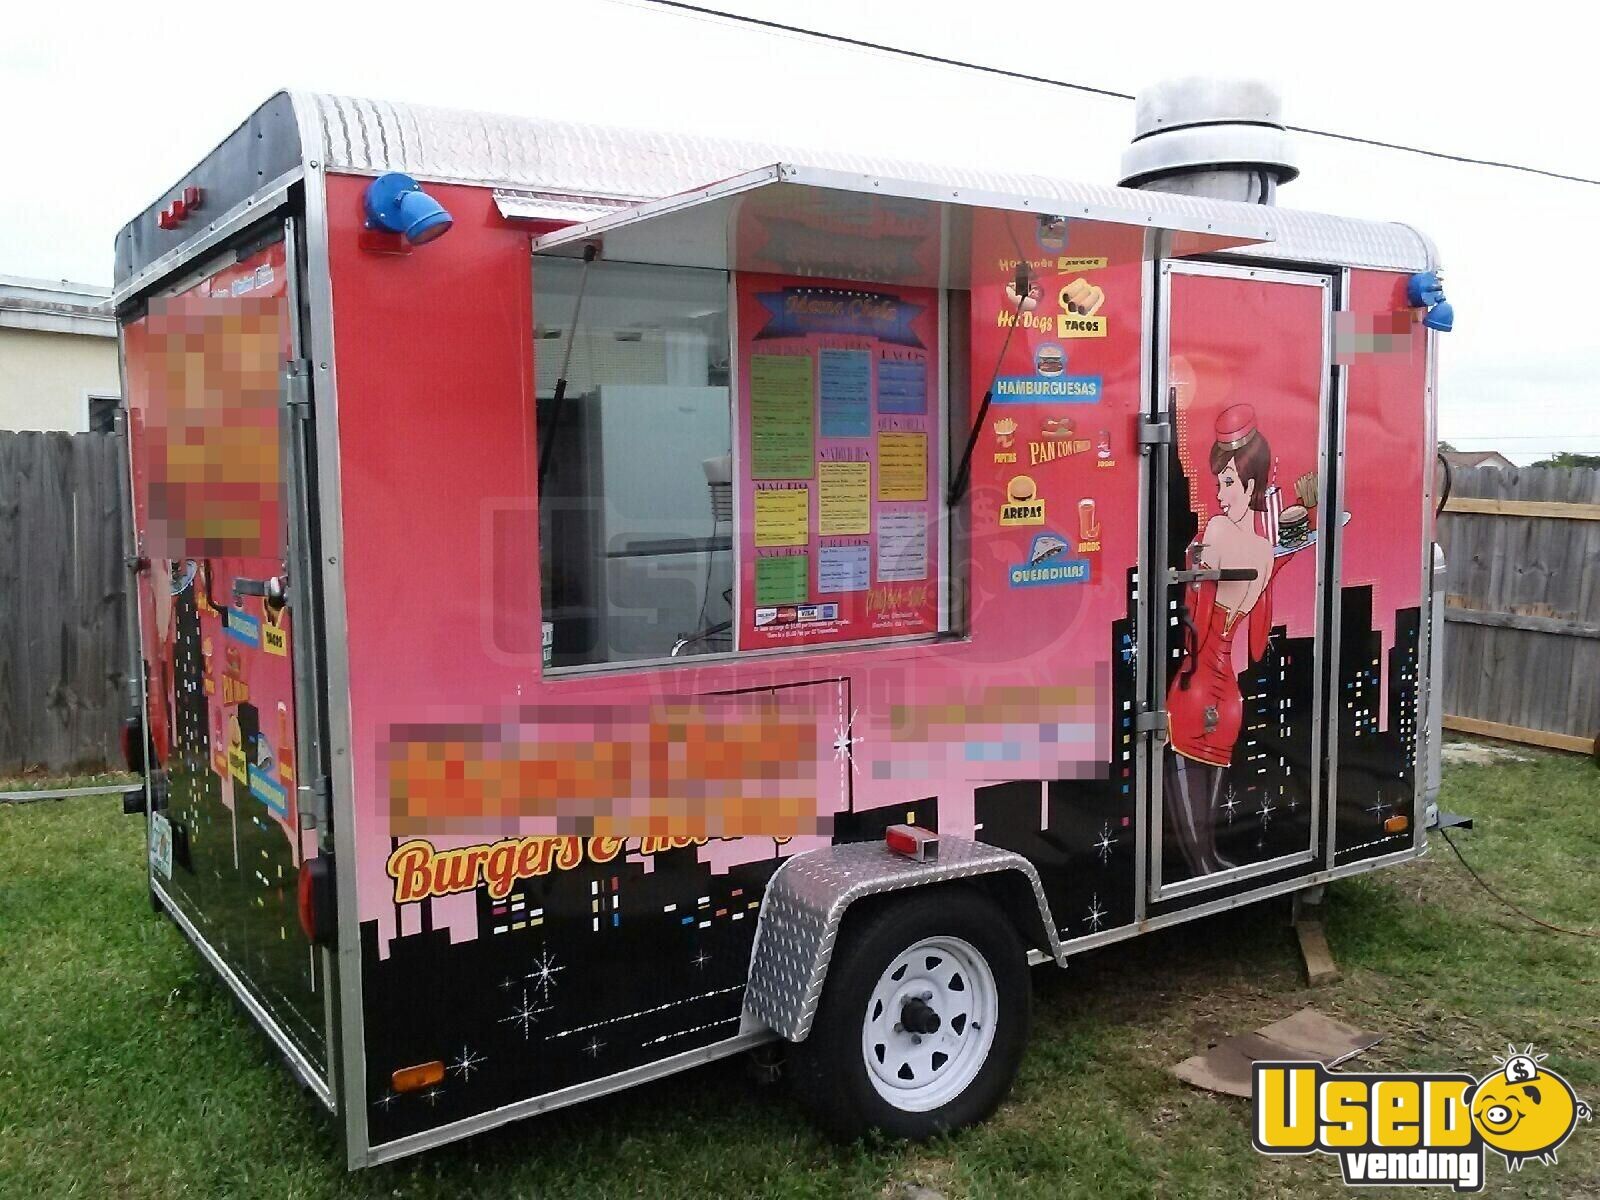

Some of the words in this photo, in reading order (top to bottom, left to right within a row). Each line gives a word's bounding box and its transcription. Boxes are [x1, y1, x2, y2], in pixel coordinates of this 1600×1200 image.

[1023, 311, 1053, 333] Dogs
[1065, 320, 1099, 331] TACOS
[997, 380, 1098, 396] HAMBURGUESAS
[1029, 440, 1056, 466] PAN
[1057, 440, 1073, 457] CON
[1003, 506, 1042, 520] AREPAS
[1078, 541, 1100, 553] JUGOS
[1012, 566, 1084, 582] QUESADILLAS
[386, 836, 582, 903] Burgers
